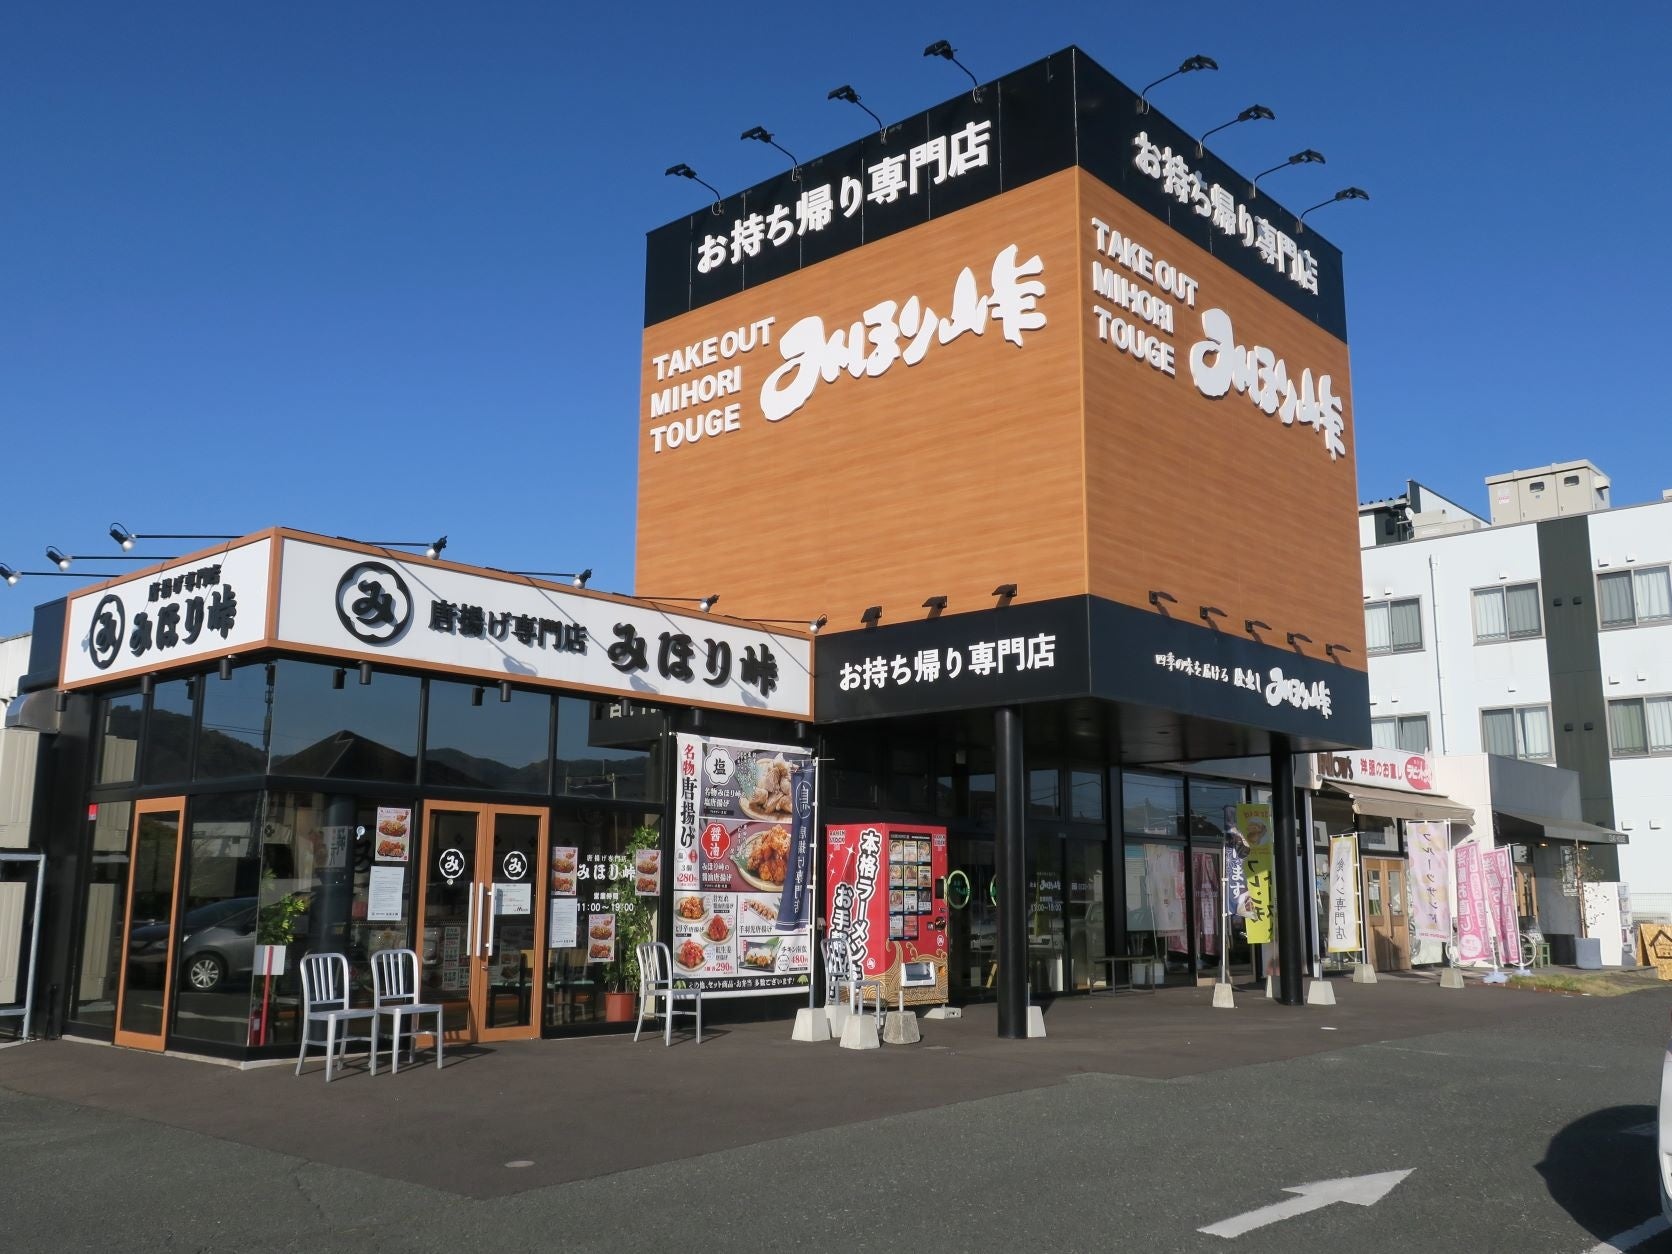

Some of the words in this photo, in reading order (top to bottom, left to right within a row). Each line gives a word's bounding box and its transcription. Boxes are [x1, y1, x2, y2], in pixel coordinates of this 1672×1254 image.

[697, 120, 991, 273] お持ち帰り専門店
[1134, 131, 1318, 295] お持ち帰り専門店
[1091, 217, 1153, 283] TAKE
[1155, 260, 1198, 308] OUT
[1092, 261, 1174, 334] MIHORI
[652, 336, 718, 381] TAKE
[720, 316, 775, 358] OUT
[760, 244, 1046, 422] みほり峠
[1093, 305, 1176, 376] TOUGE
[650, 366, 741, 418] MIHORI
[650, 403, 740, 453] TOUGE
[130, 583, 238, 657] みほり峠
[428, 599, 588, 655] 唐揚げ専門店
[607, 622, 778, 697] みほり峠
[839, 633, 1056, 692] お持ち帰り専門店
[680, 744, 698, 848] 名物唐揚げ
[712, 757, 727, 776] 塩
[577, 864, 635, 881] みほり峠
[709, 826, 722, 857] 醤油
